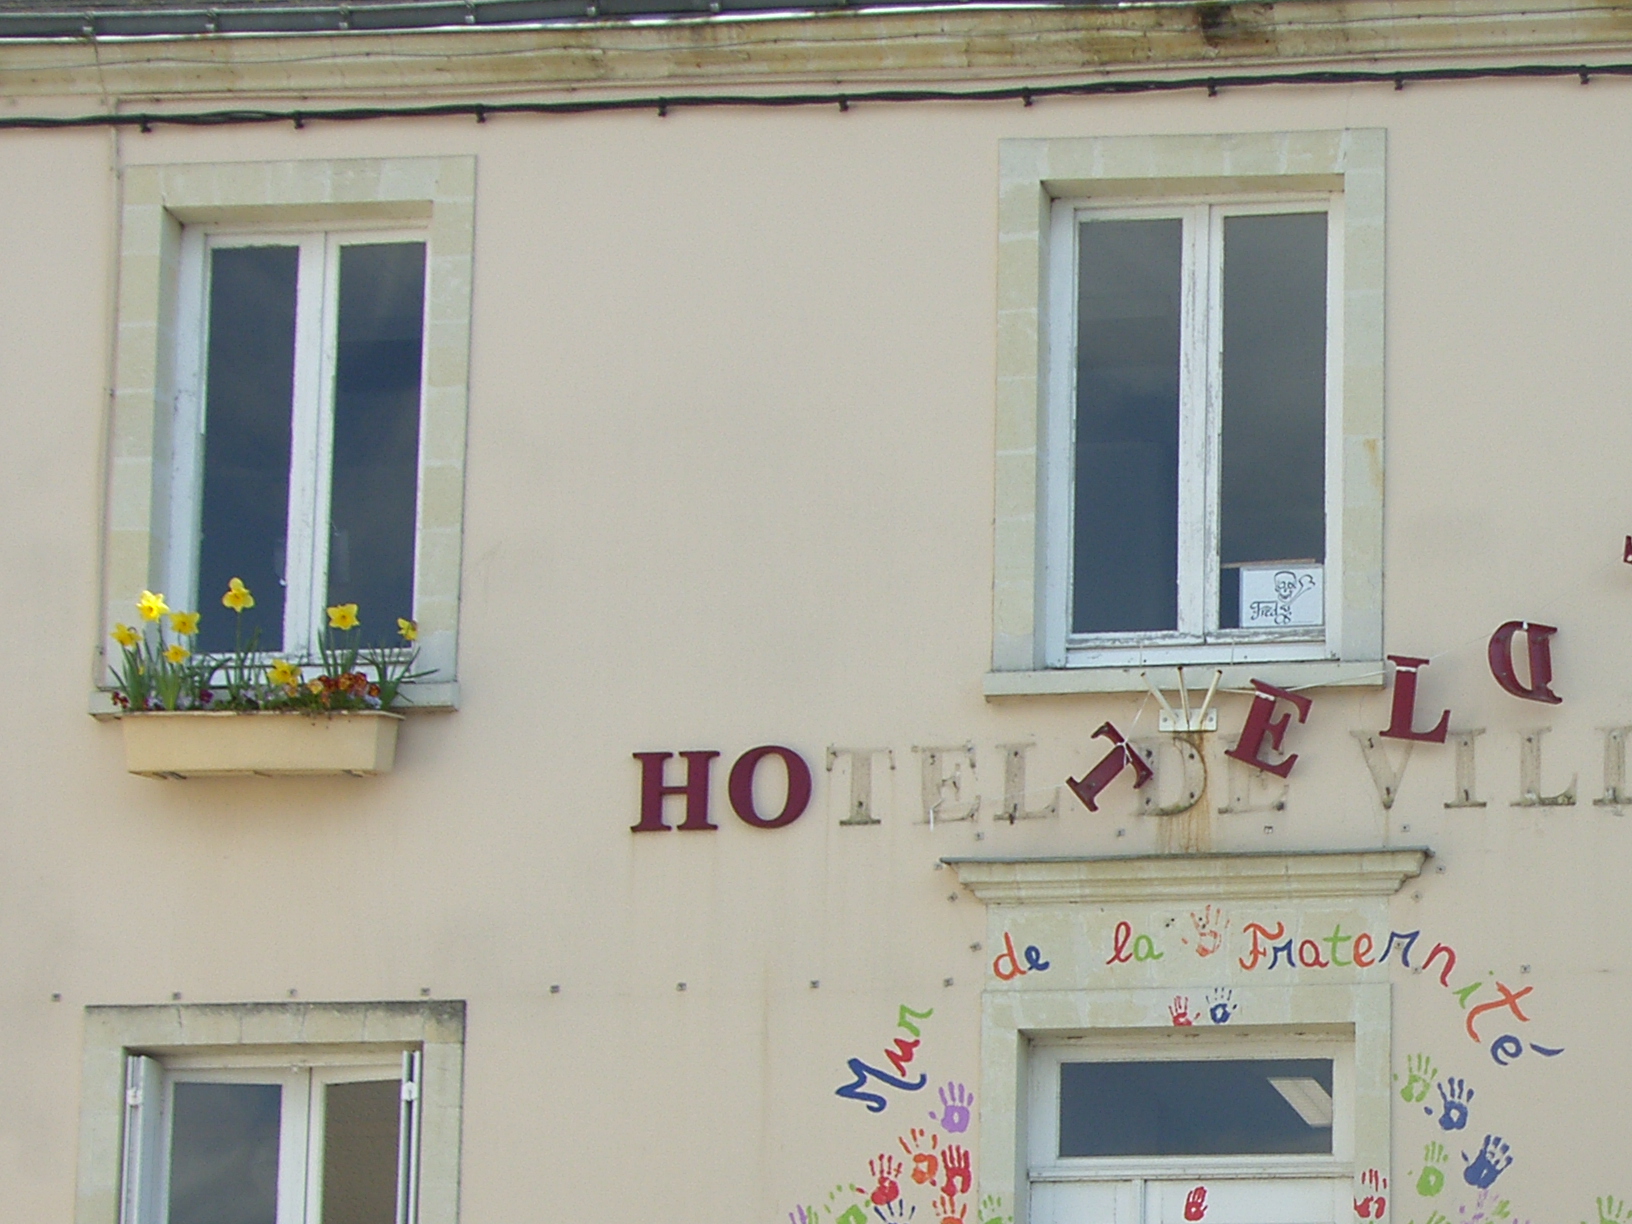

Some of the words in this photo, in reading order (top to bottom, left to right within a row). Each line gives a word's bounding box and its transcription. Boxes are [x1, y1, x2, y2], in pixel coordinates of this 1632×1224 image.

[630, 741, 1060, 833] HOTEL
[835, 1003, 935, 1114] Mur
[992, 932, 1050, 981] de
[1106, 921, 1164, 965] la
[1238, 920, 1566, 1067] Fraternité
